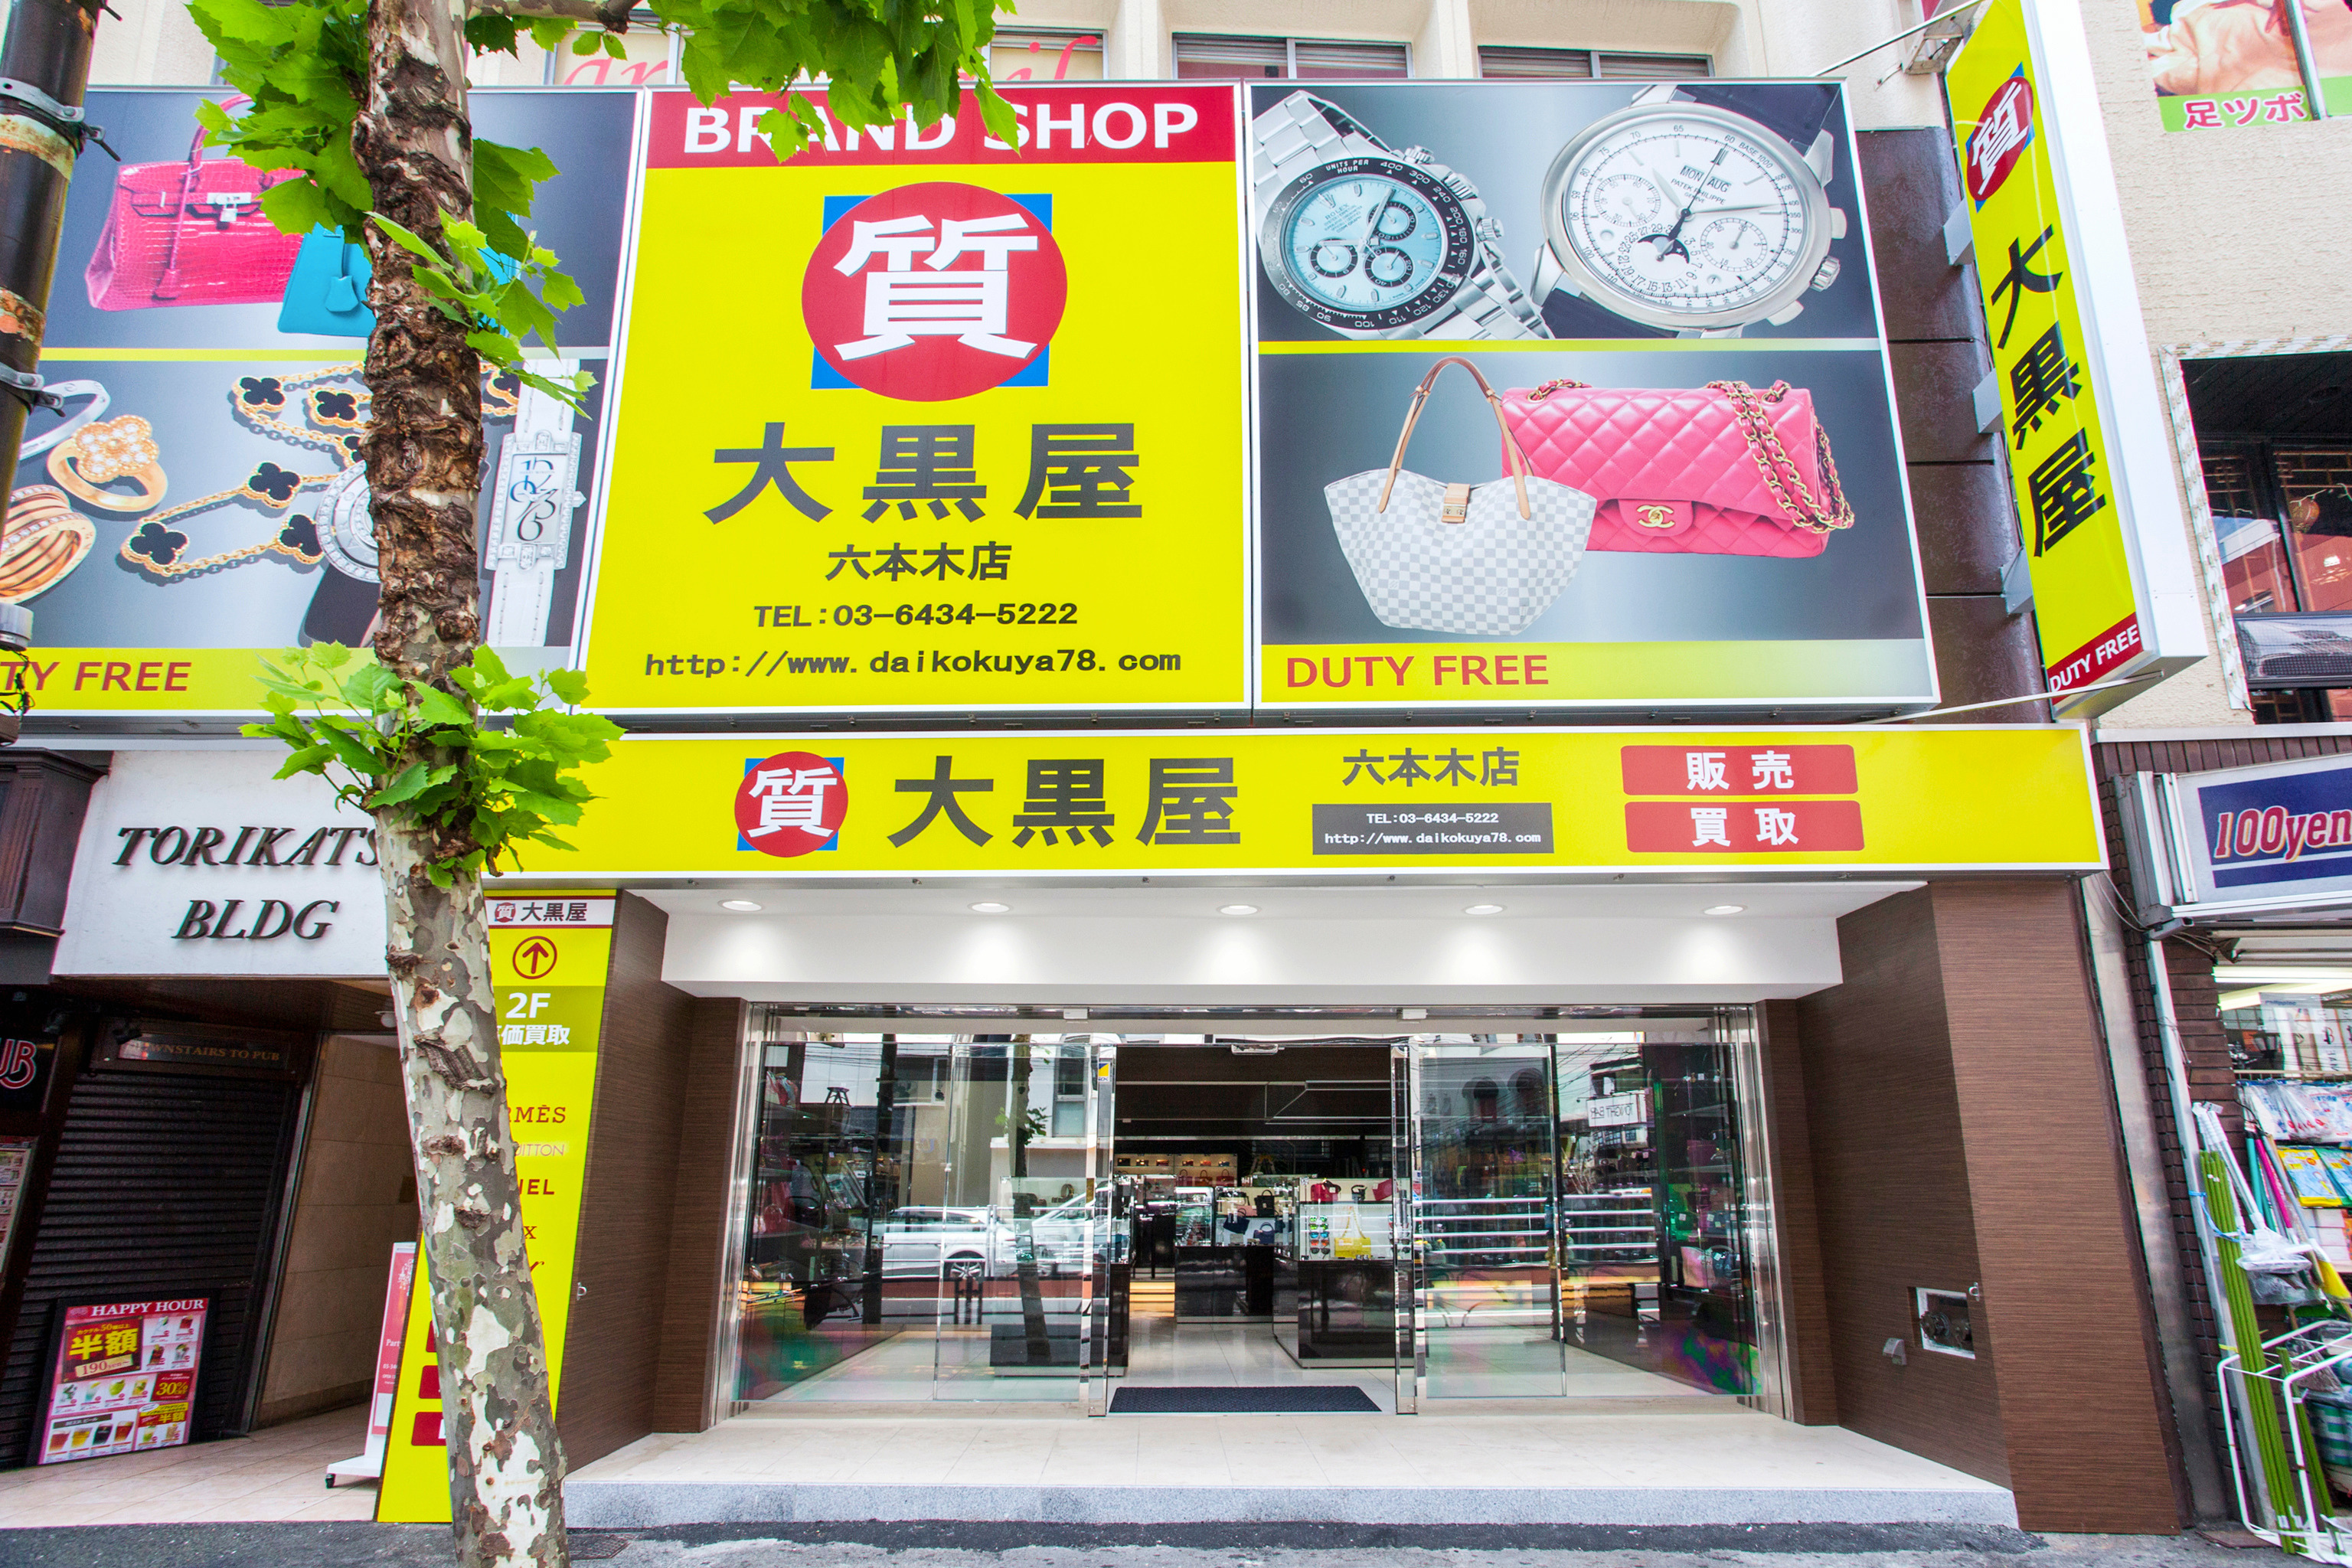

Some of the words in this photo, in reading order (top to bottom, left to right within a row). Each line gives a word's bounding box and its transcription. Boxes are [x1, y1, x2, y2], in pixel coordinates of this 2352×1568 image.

[984, 102, 1198, 151] SHOP
[2184, 92, 2306, 130] 足ツボ
[1971, 81, 2028, 194] 質
[1325, 161, 1348, 171] UNITS
[1680, 166, 1704, 181] MON
[1707, 177, 1729, 192] AUG
[834, 214, 1038, 361] 質
[1991, 223, 2106, 557] 大黒屋
[702, 422, 1142, 525] 大黒屋
[825, 541, 1013, 582] 六本木店
[753, 603, 1078, 629] TEL:03-6434-5222
[74, 662, 191, 691] FREE
[1287, 656, 1415, 688] DUTY
[1433, 654, 1549, 686] FREE
[2050, 653, 2091, 692] DUTY
[2096, 623, 2140, 665] FREE
[1342, 746, 1519, 787] 六本木店
[748, 767, 838, 838] 質
[887, 755, 1241, 848] 大黒屋
[1367, 813, 1498, 824] TEL:03-6434-5222
[112, 826, 381, 866] TORIKATS
[2213, 805, 2352, 863] 100yen
[170, 899, 341, 939] BLDG
[521, 902, 587, 922] 大黒屋
[505, 992, 551, 1018] 2F
[230, 1050, 249, 1059] TO
[251, 1051, 280, 1061] PUB
[91, 1302, 152, 1317] HAPPY
[155, 1299, 204, 1312] HOUR
[69, 1328, 138, 1361] 半額
